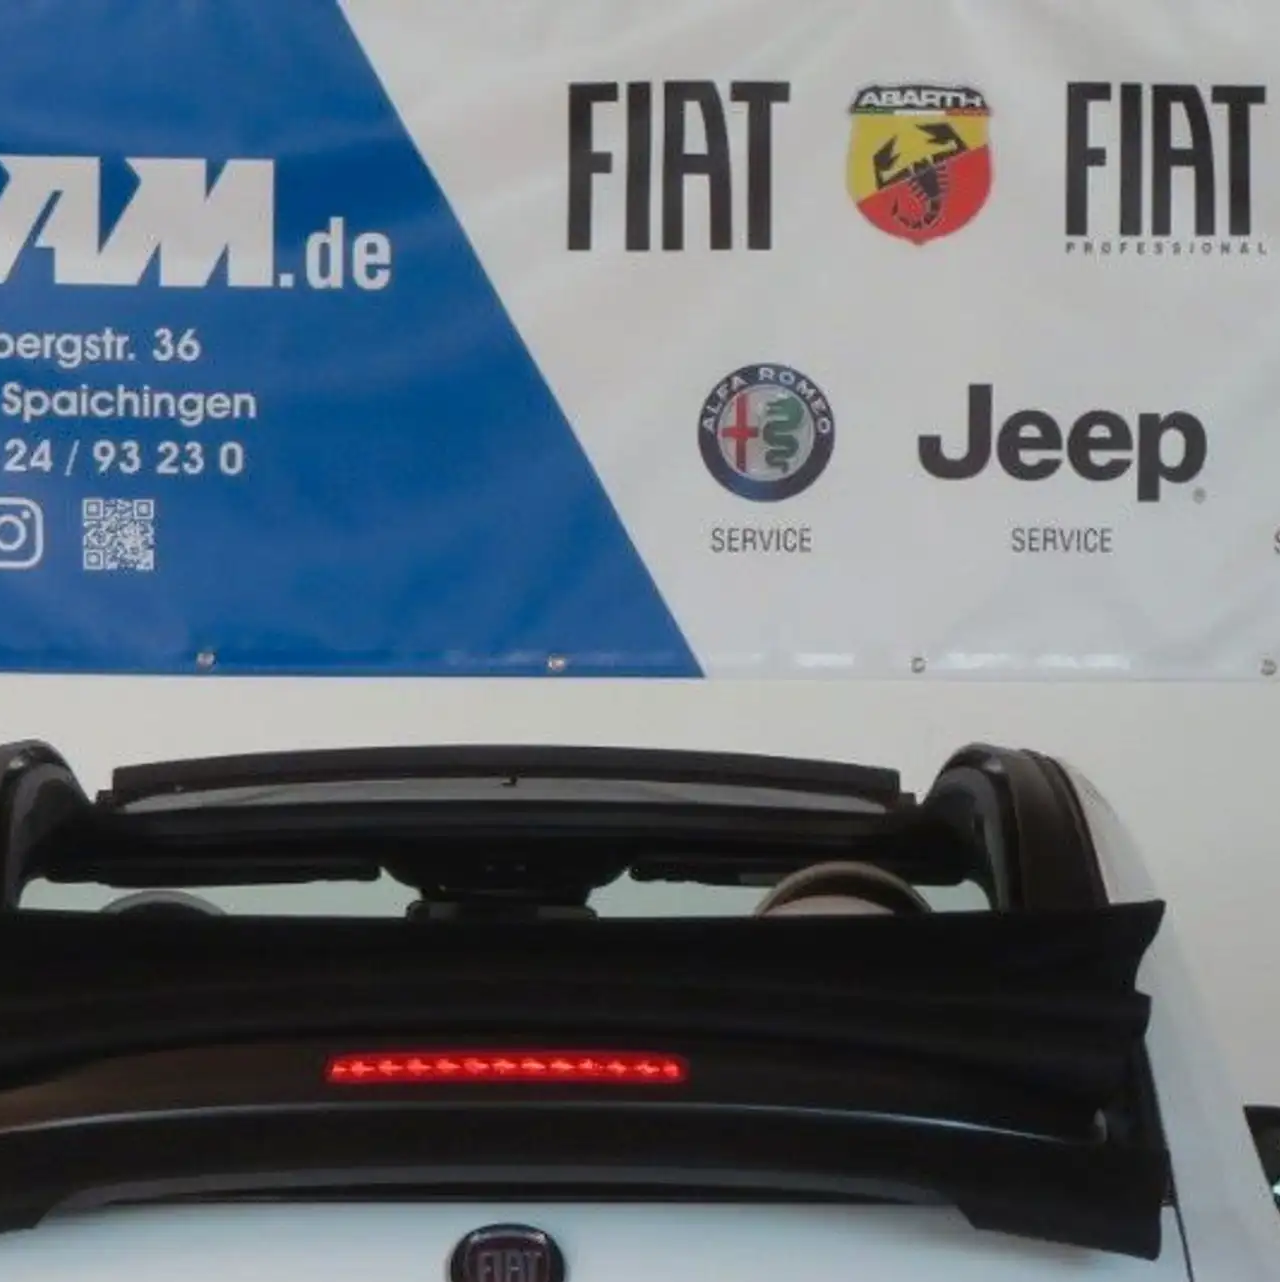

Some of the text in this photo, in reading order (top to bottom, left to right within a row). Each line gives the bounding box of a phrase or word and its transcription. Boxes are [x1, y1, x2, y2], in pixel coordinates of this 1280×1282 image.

[859, 89, 983, 108] ABARTH
[567, 80, 790, 251] FIAT
[1066, 82, 1265, 236] FIAT
[1066, 242, 1267, 255] PROFESSIONAL
[152, 327, 201, 362] 36
[1, 382, 257, 426] Spaichingen
[703, 367, 831, 434] ALFA ROMEO
[4, 439, 52, 472] 24
[93, 441, 142, 473] 93
[156, 442, 204, 474] 23
[220, 442, 243, 475] 0
[918, 384, 1207, 502] Jeep
[711, 527, 812, 552] SERVICE
[1012, 528, 1113, 553] SERVICE
